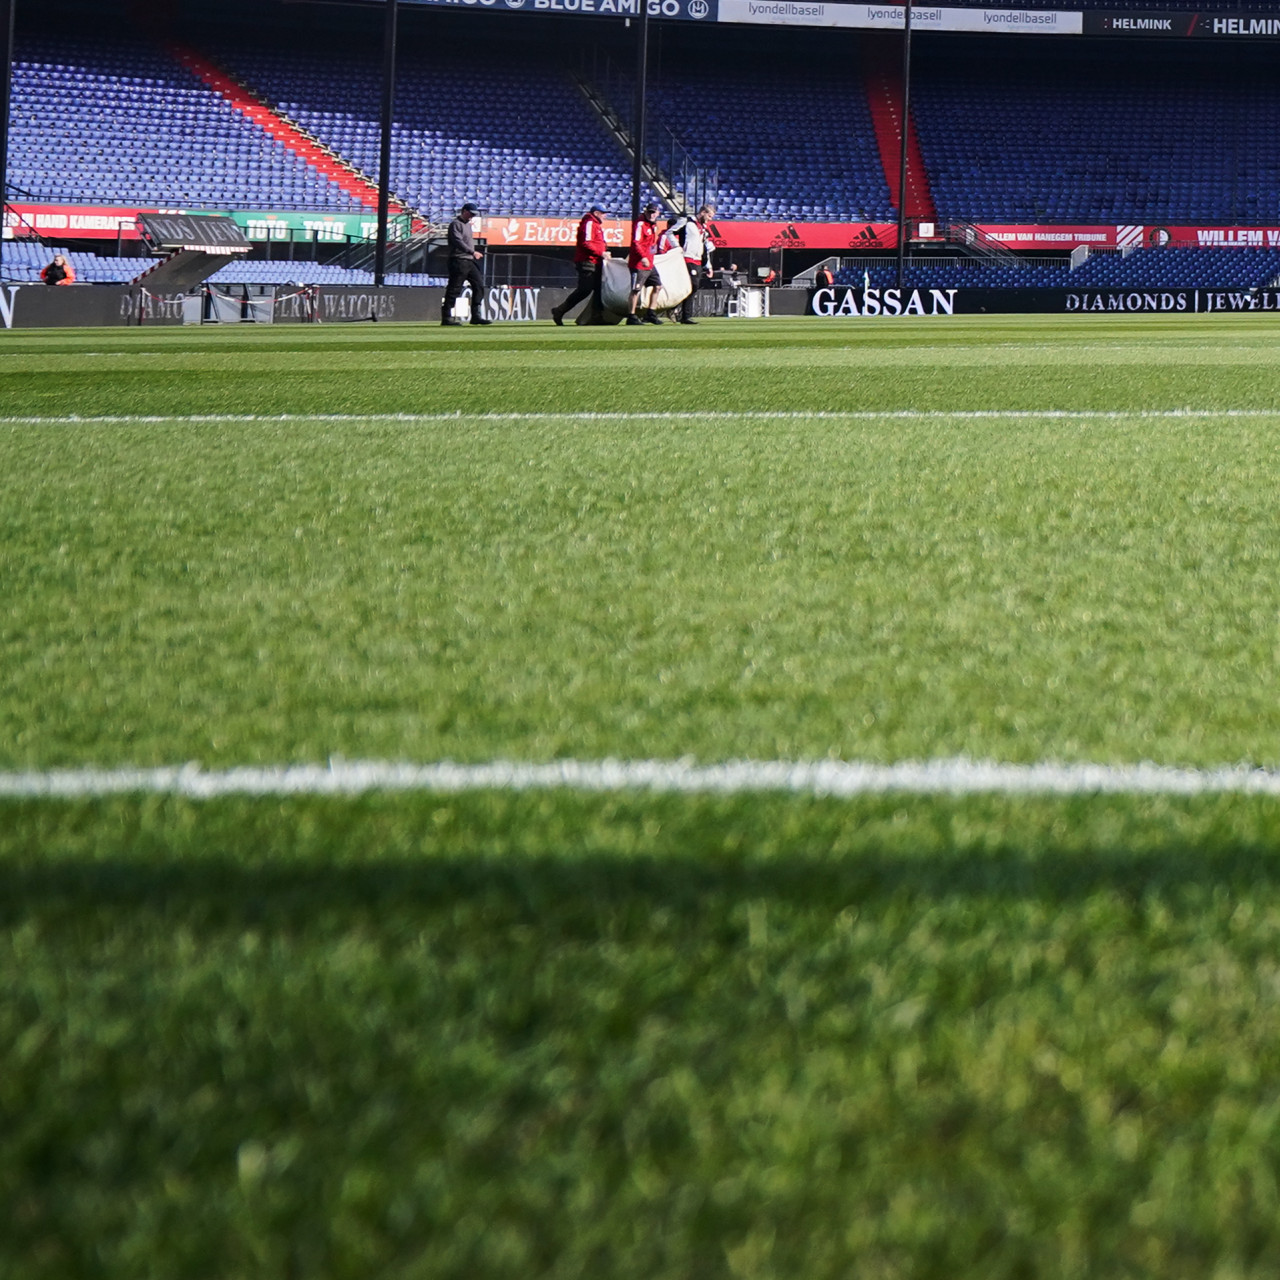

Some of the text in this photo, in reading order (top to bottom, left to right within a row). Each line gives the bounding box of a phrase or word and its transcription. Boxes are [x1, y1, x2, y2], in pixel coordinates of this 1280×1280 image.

[748, 2, 825, 17] lyondellbasell
[867, 7, 942, 21] lyondelbasell
[983, 11, 1057, 24] lyondellbasell
[1112, 18, 1172, 31] HELMINK
[247, 220, 288, 239] TOTO
[303, 221, 346, 240] TOTO
[1197, 230, 1263, 246] WILLEM
[812, 289, 958, 316] GASSAN
[1065, 293, 1187, 311] DIAMONDS
